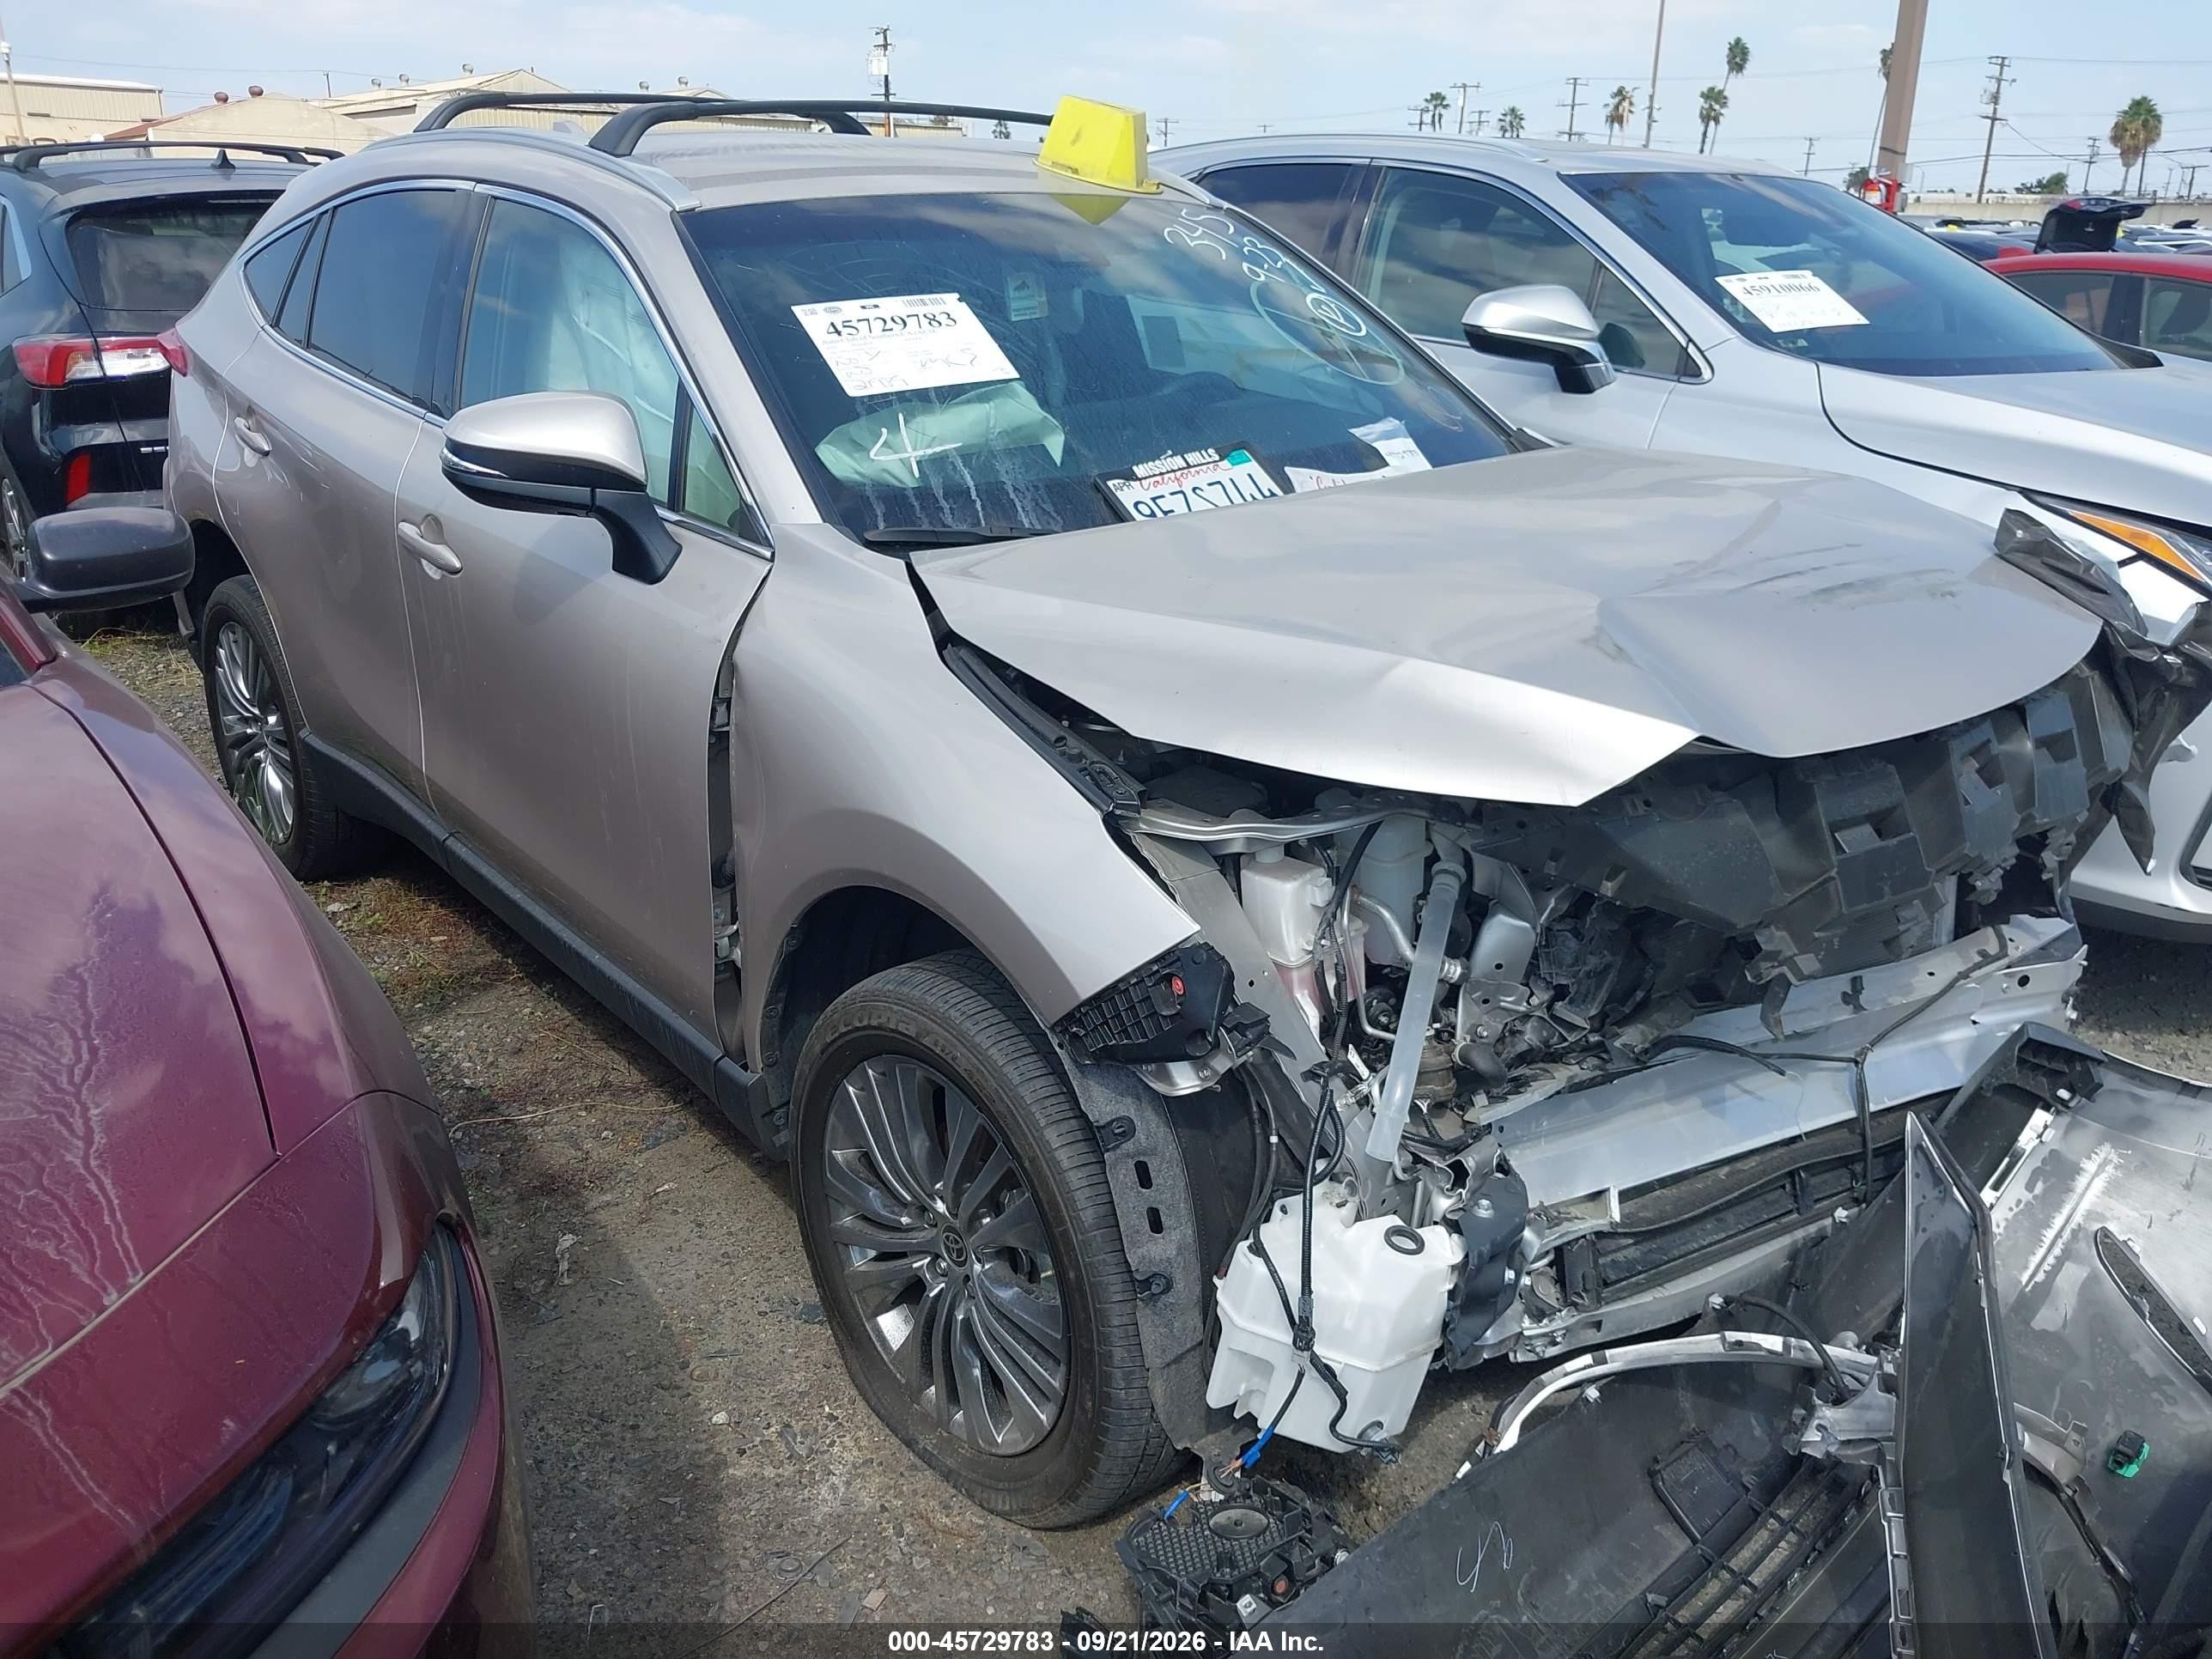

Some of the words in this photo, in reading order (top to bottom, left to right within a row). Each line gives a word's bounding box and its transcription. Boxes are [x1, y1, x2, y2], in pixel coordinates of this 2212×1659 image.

[1164, 209, 1239, 260] 345
[1742, 283, 1821, 296] 45910066
[826, 312, 957, 337] 45729783
[870, 413, 962, 478] 4
[1132, 455, 1187, 478] MISSION
[1183, 448, 1219, 465] HILLS
[1112, 481, 1135, 493] APR
[1139, 465, 1234, 491] California
